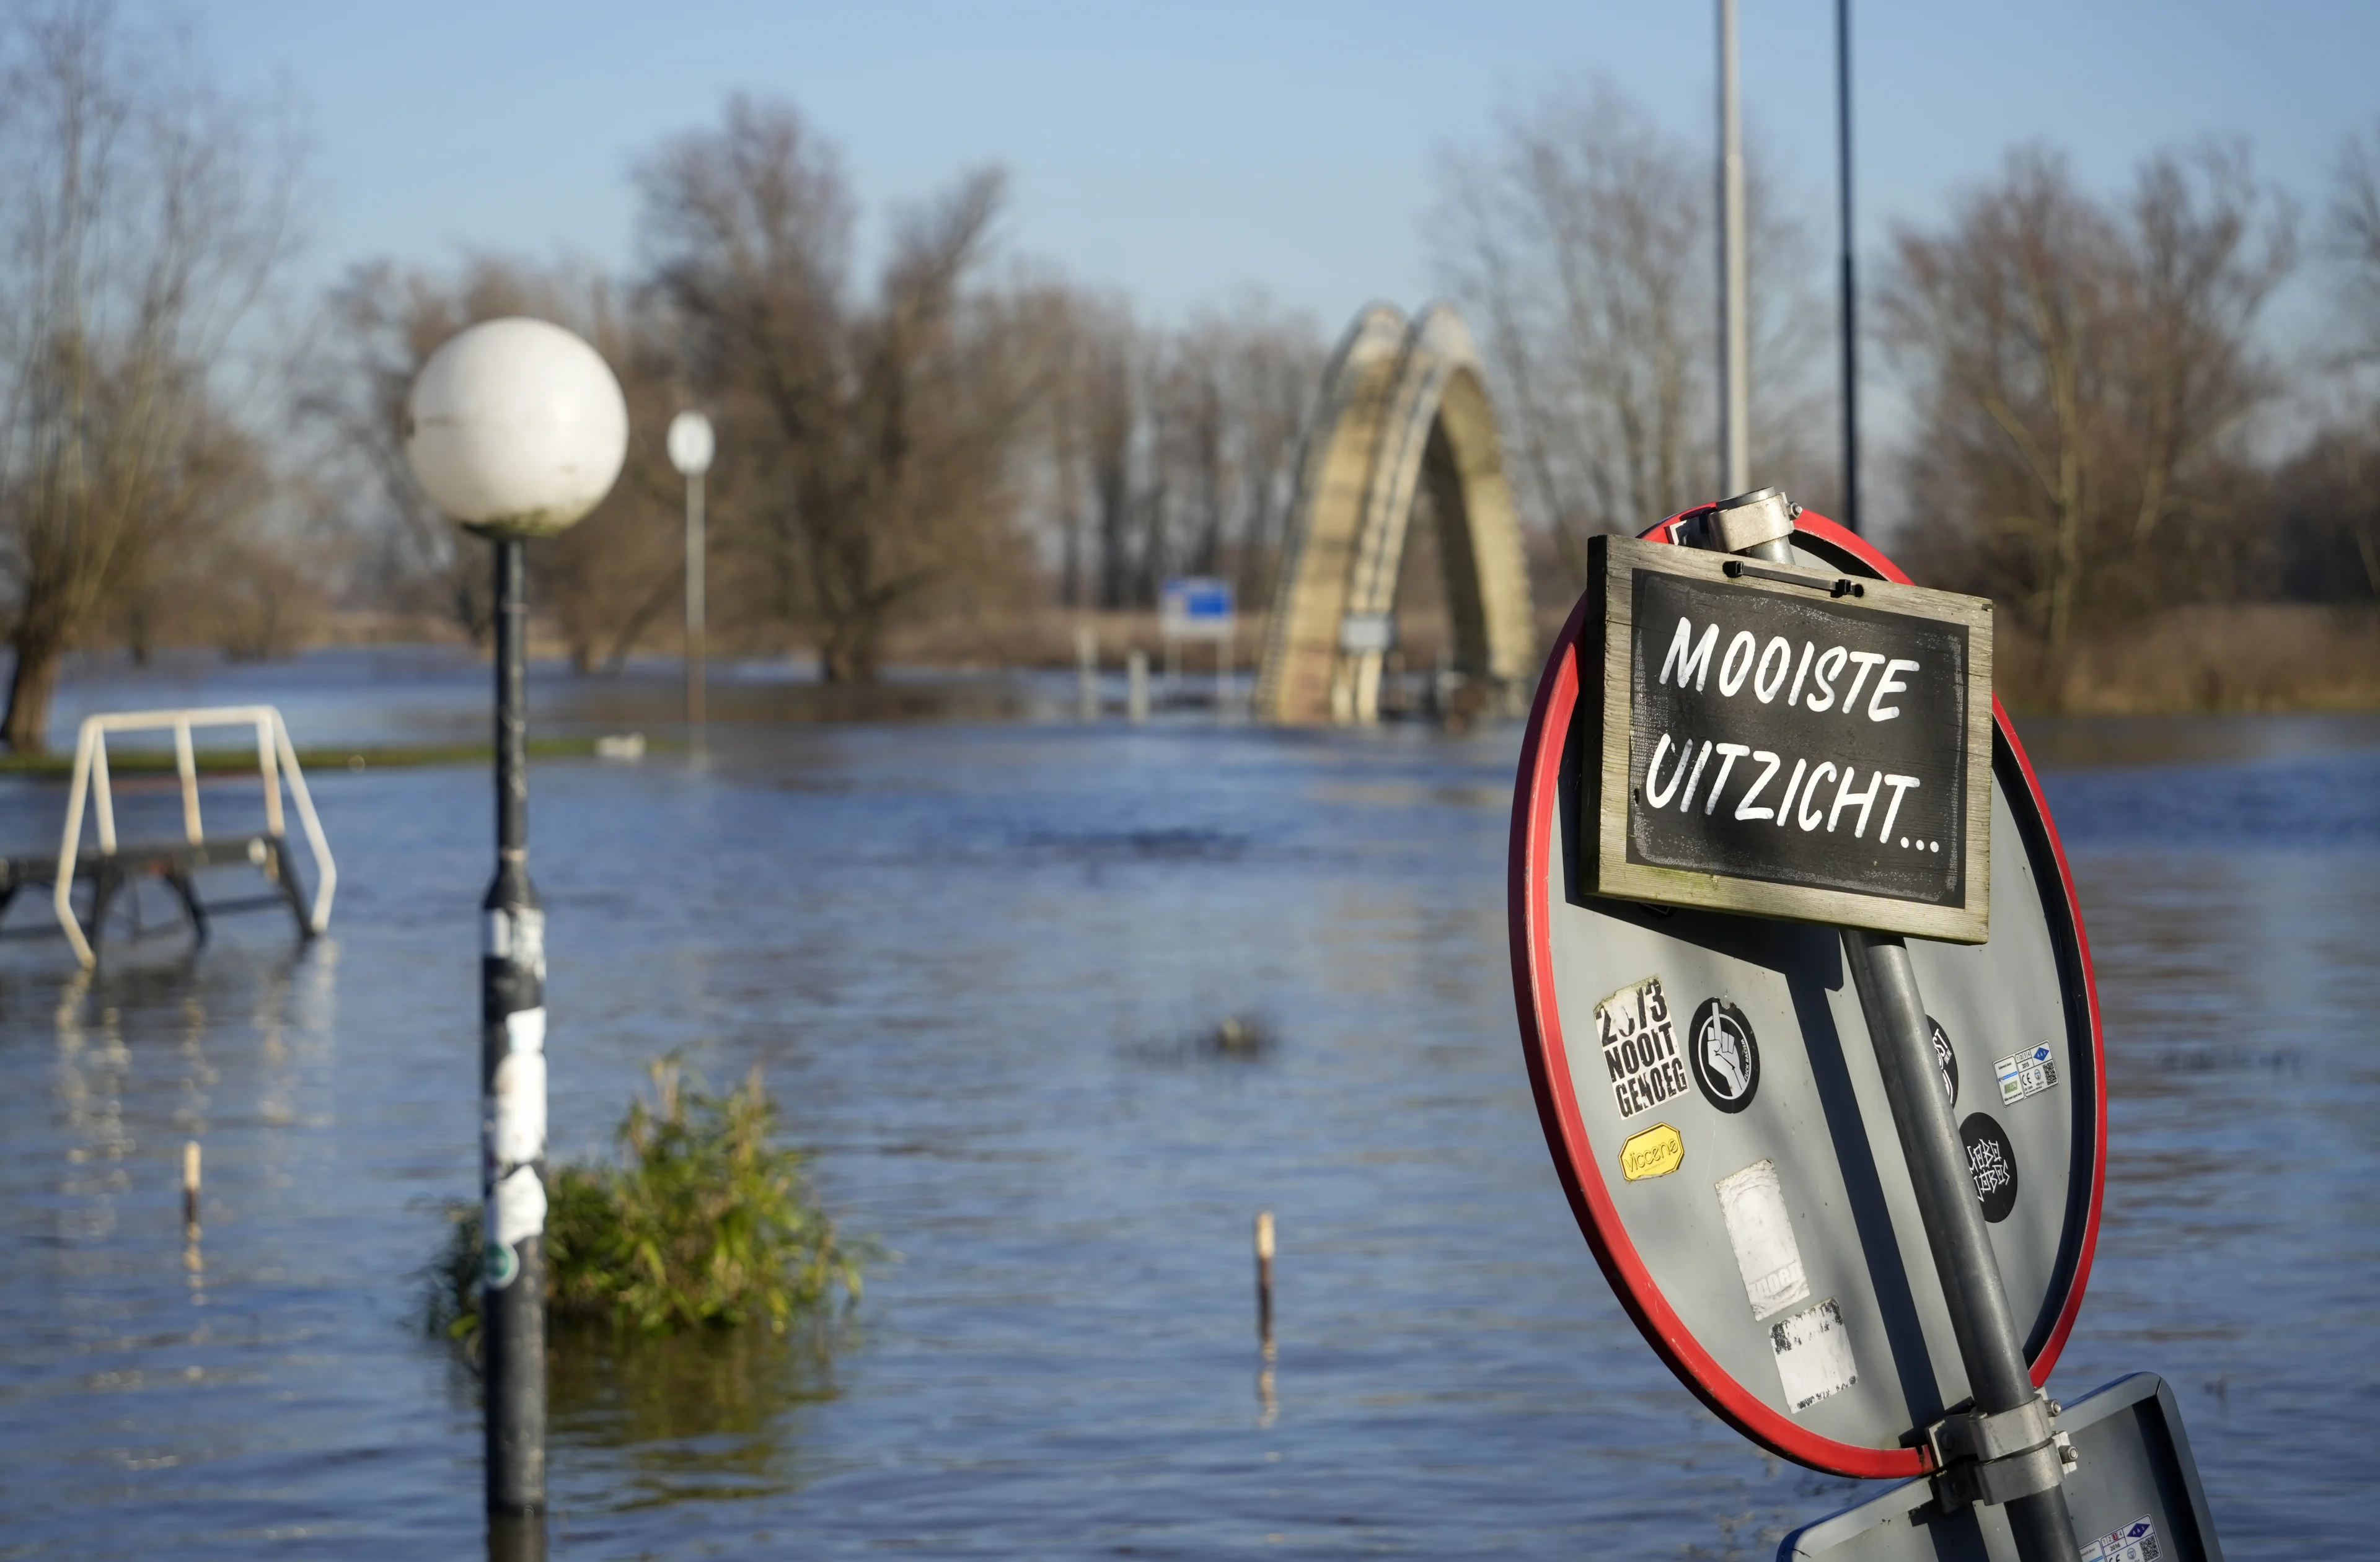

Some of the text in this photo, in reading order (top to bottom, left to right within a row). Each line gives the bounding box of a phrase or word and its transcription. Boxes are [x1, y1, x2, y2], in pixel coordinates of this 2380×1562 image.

[1659, 616, 1921, 722] MOOISTE
[1646, 733, 1940, 853] UITZICHT...
[1604, 1021, 1675, 1083] NOOIT
[1740, 1038, 1750, 1063] RACISM
[2022, 1072, 2032, 1086] CE
[1615, 1057, 1688, 1118] GENOEG
[2110, 1542, 2121, 1551] 2016
